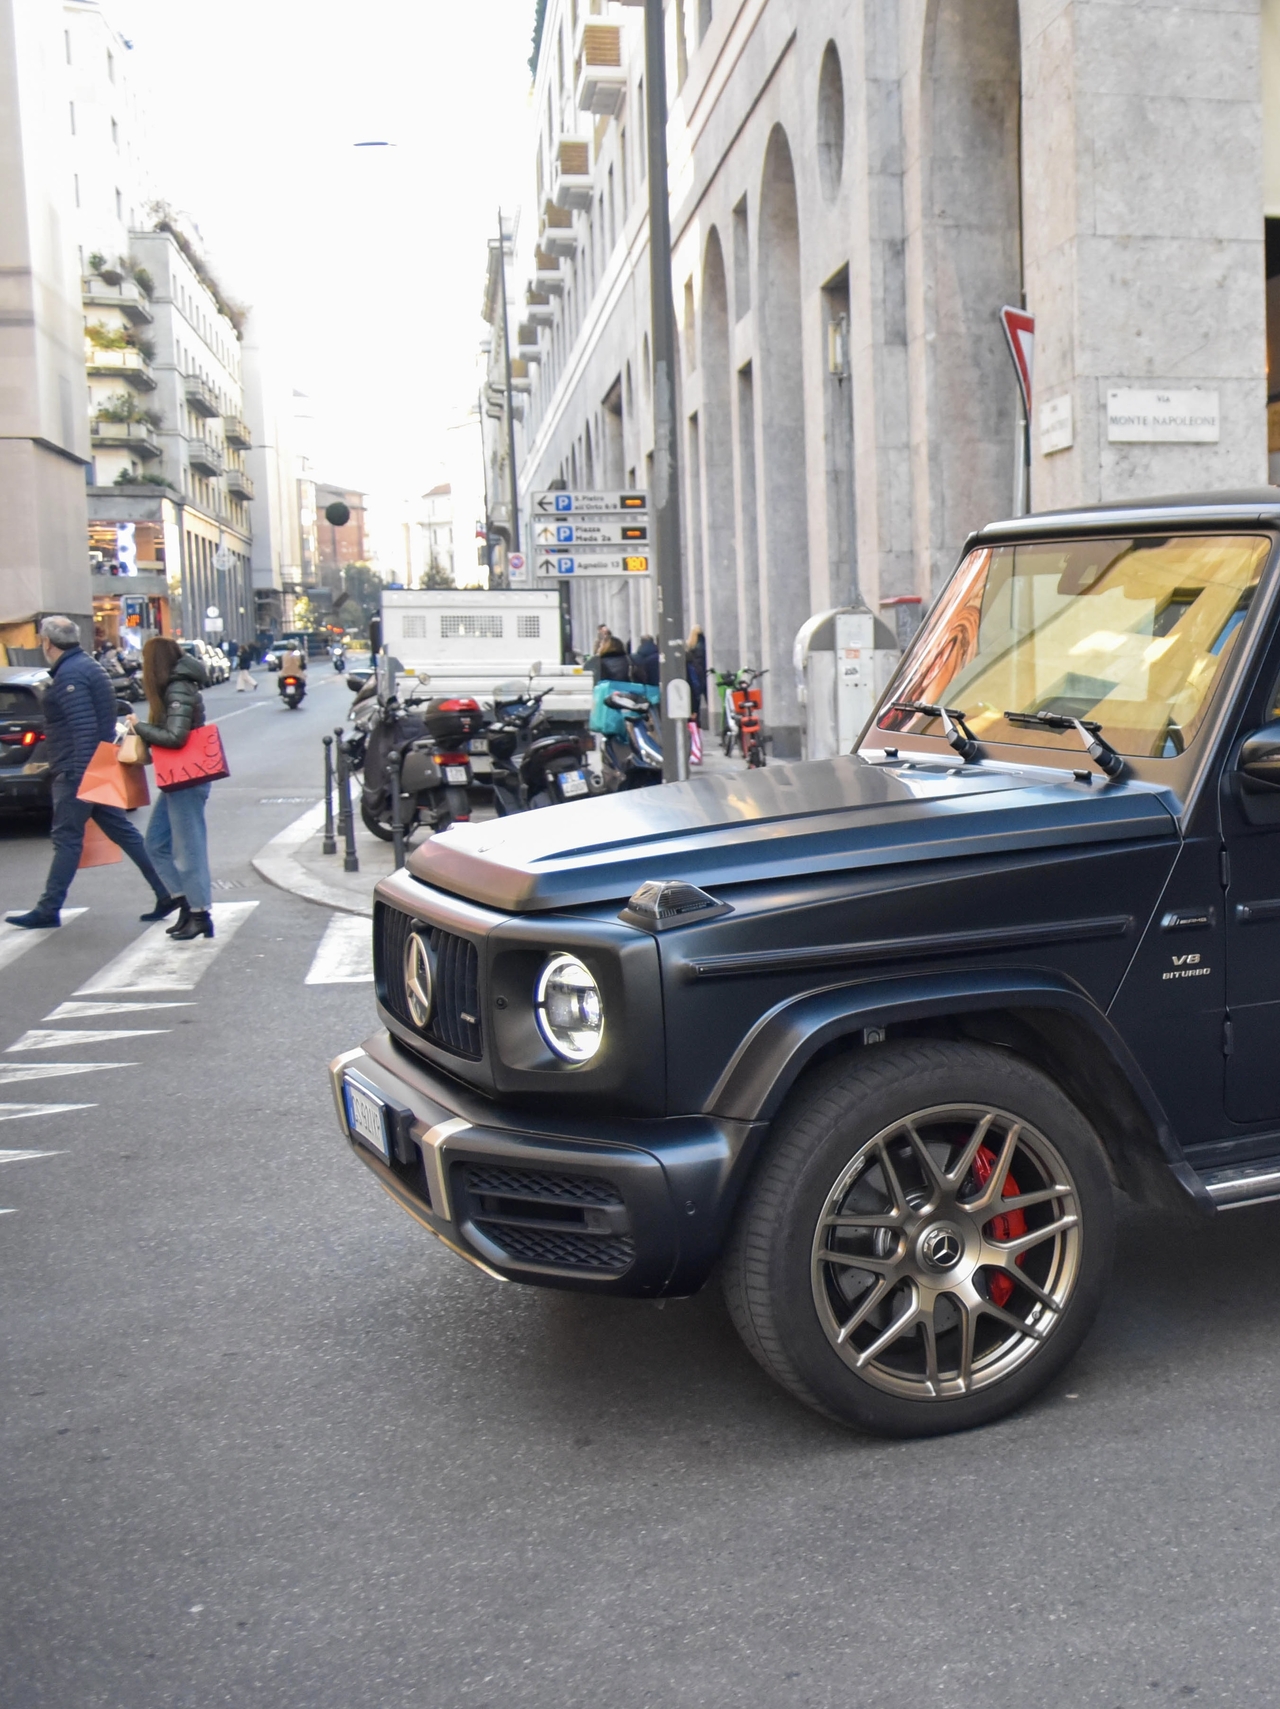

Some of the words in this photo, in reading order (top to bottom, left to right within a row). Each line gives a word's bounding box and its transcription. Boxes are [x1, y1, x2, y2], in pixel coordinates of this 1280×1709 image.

[1109, 415, 1148, 426] MONTE
[1152, 415, 1217, 426] NAPOLEONE
[1172, 954, 1201, 966] V8
[1162, 967, 1211, 980] BITURBO
